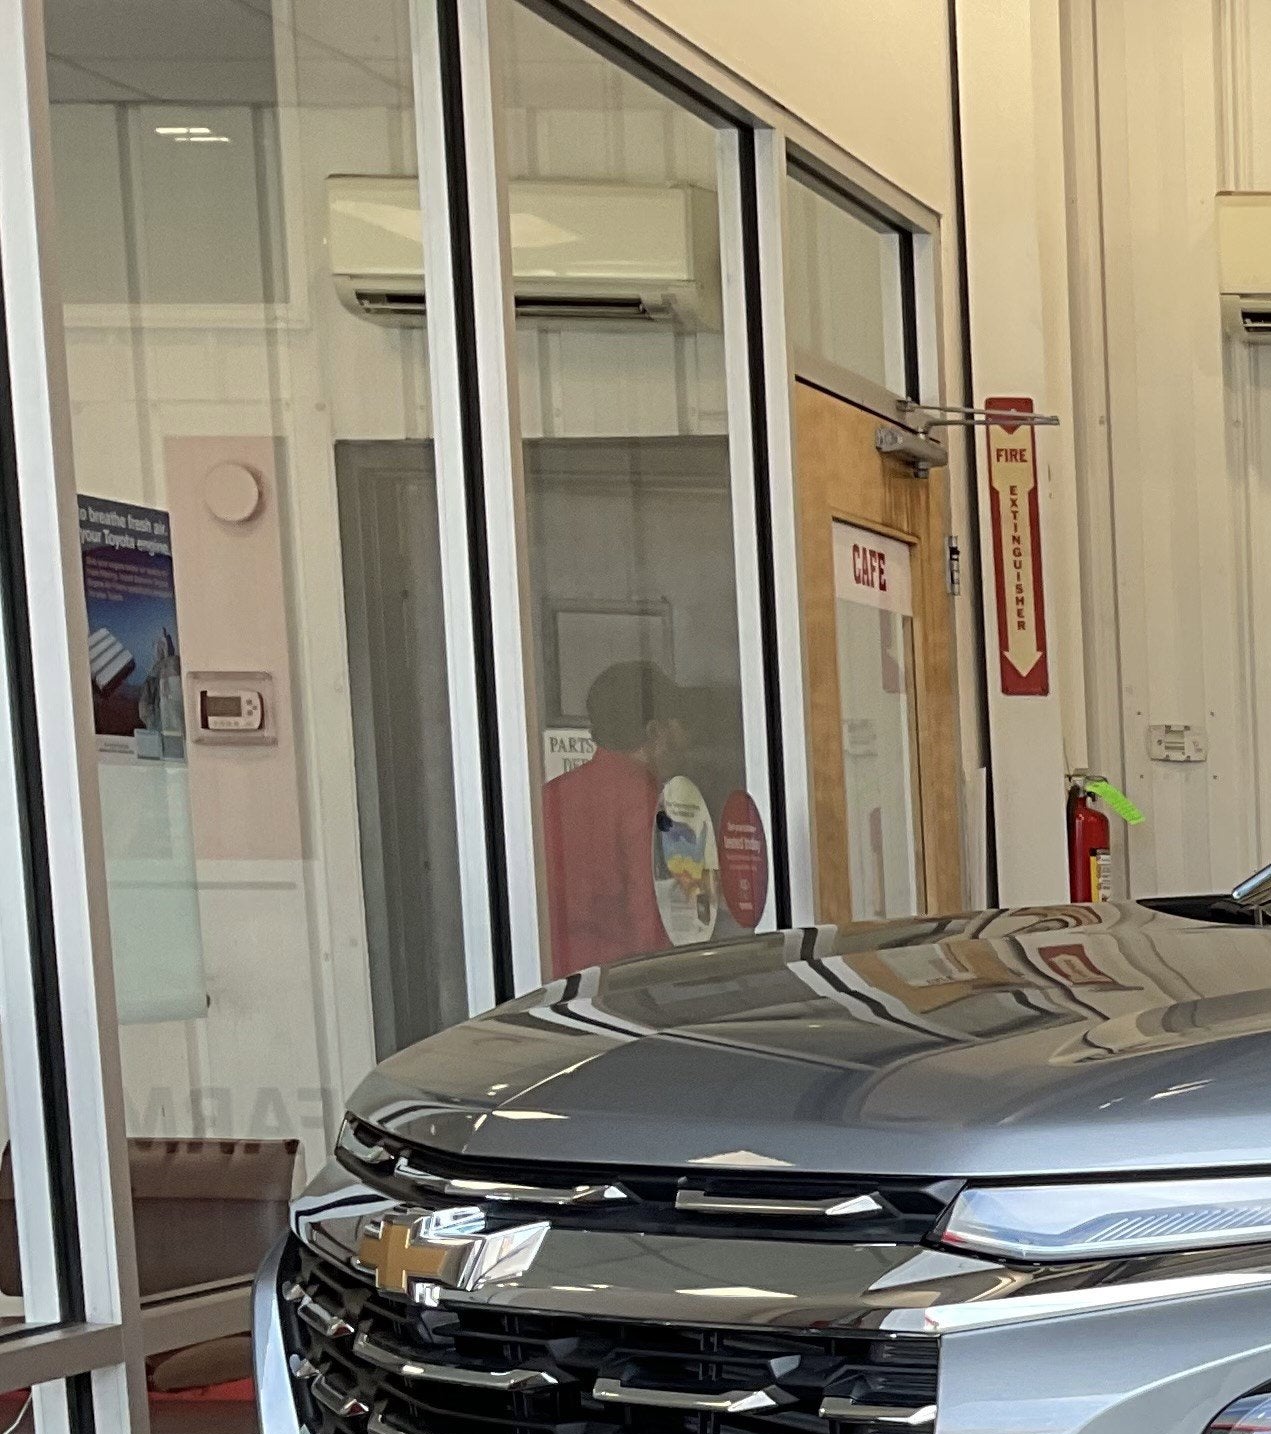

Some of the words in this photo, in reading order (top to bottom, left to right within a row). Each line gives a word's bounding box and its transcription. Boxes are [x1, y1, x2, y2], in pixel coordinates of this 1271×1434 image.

[996, 448, 1028, 463] FIRE
[103, 529, 135, 550] Toyota
[852, 543, 887, 592] CAFE
[1009, 485, 1026, 631] EXTINGUISHER
[549, 736, 594, 754] PARTS
